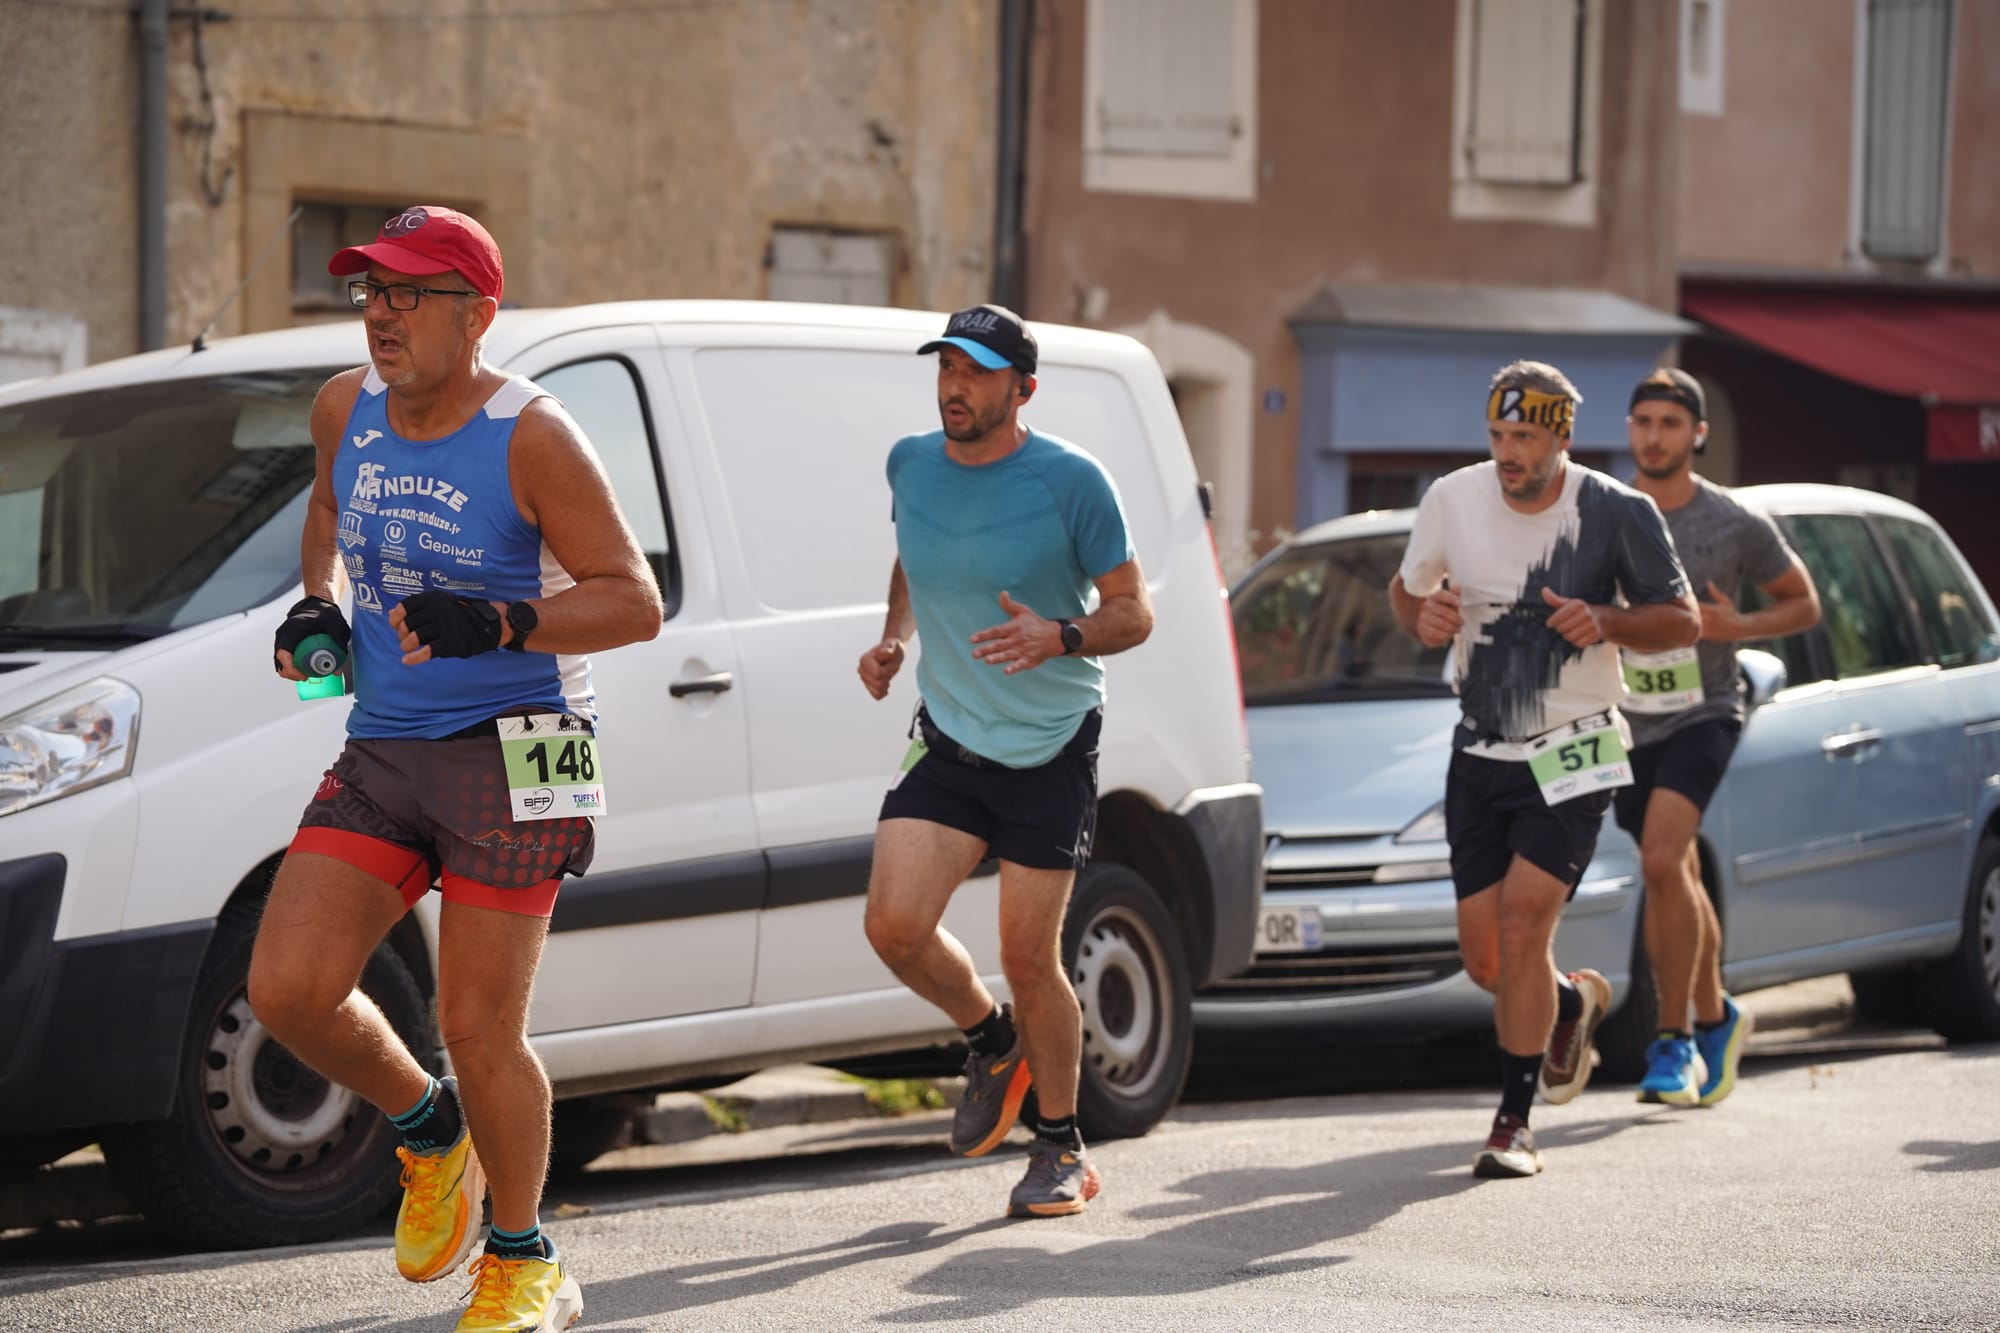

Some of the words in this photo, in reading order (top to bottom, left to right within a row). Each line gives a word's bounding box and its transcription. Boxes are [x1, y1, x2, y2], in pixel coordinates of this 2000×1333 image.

[385, 213, 424, 229] CTC
[379, 507, 461, 535] www.acn-anduze.fr
[456, 557, 481, 567] Manen
[1635, 669, 1676, 692] 38
[526, 740, 595, 783] 148
[1558, 736, 1599, 771] 57
[523, 797, 550, 807] BFP
